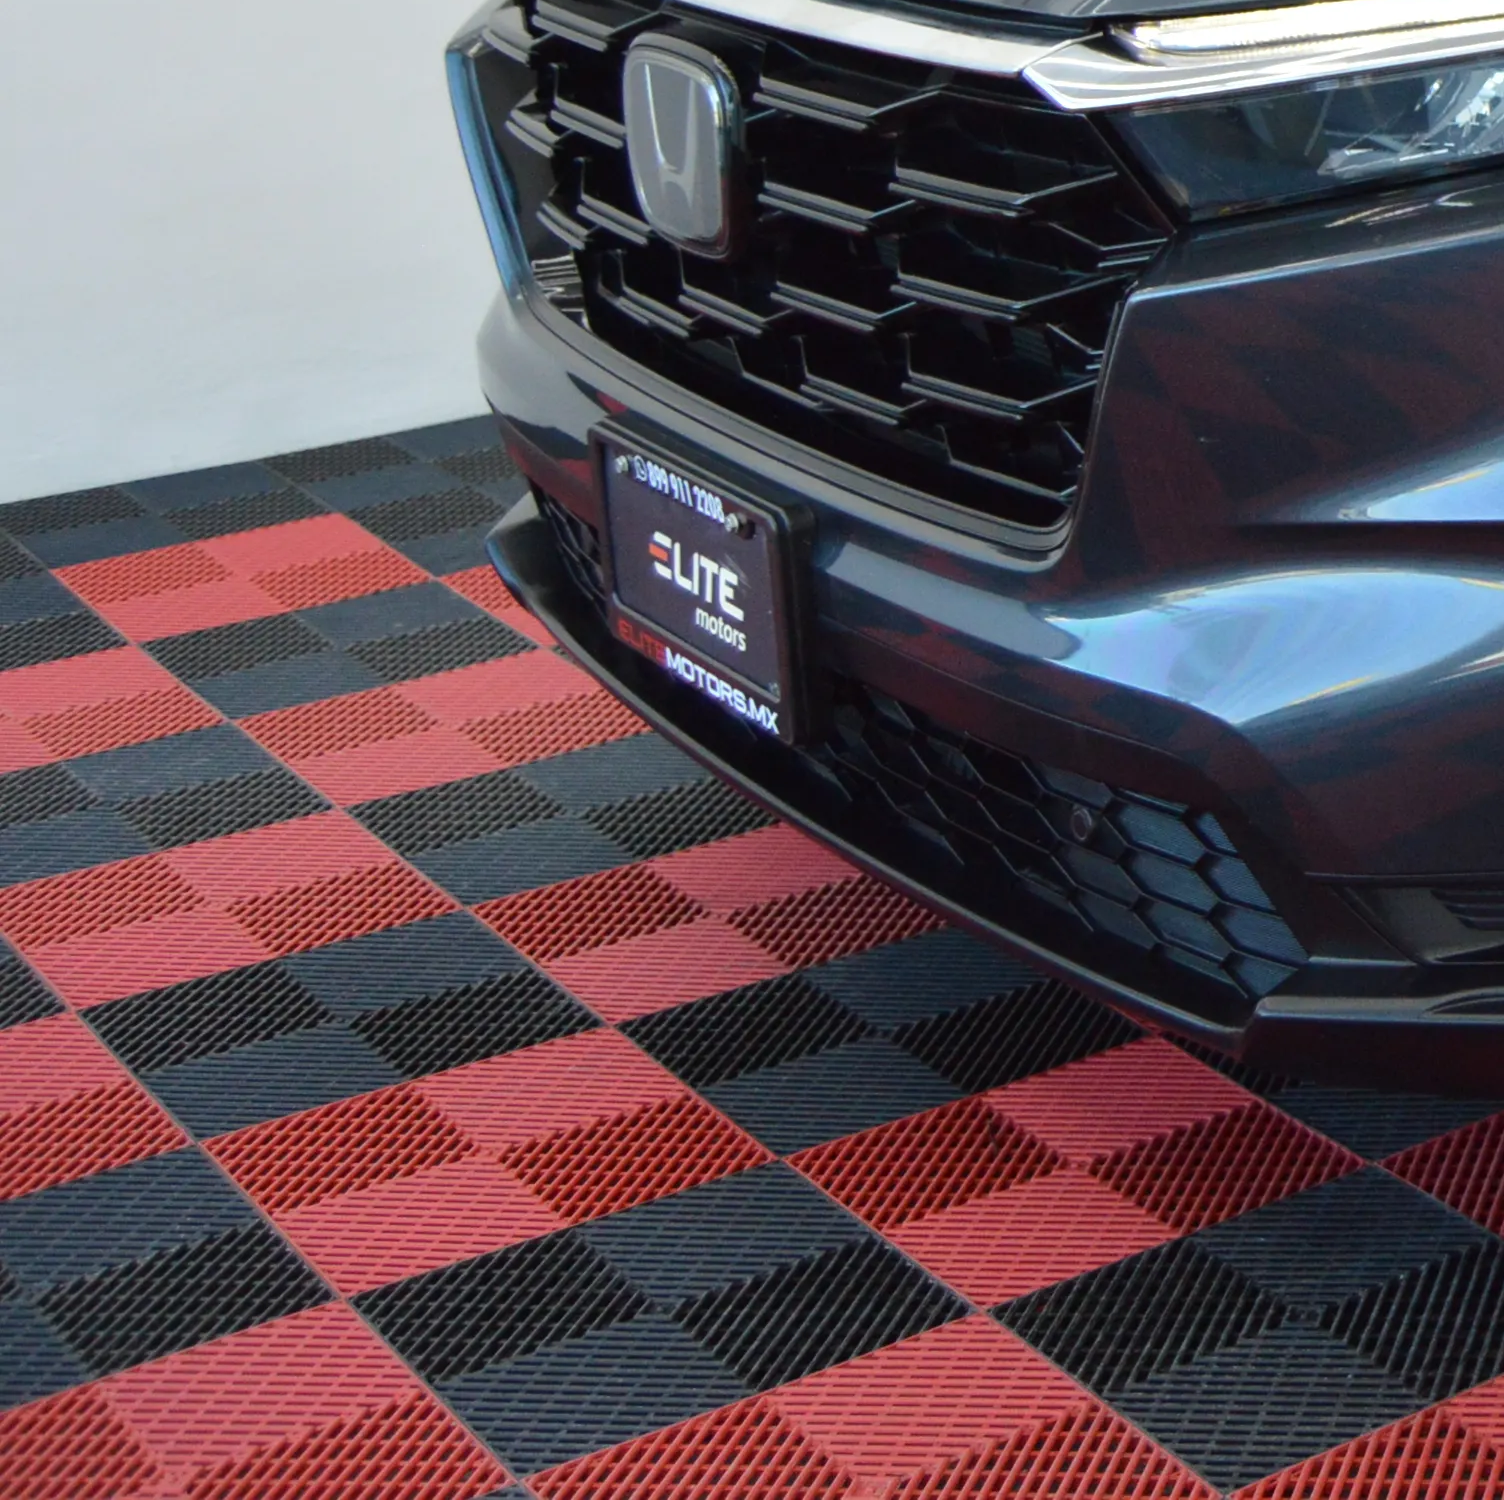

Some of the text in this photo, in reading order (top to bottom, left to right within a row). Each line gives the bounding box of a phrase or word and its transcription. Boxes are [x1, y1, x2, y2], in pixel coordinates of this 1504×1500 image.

[669, 472, 694, 508] 911
[649, 531, 744, 621] ELITE
[695, 607, 747, 652] motors
